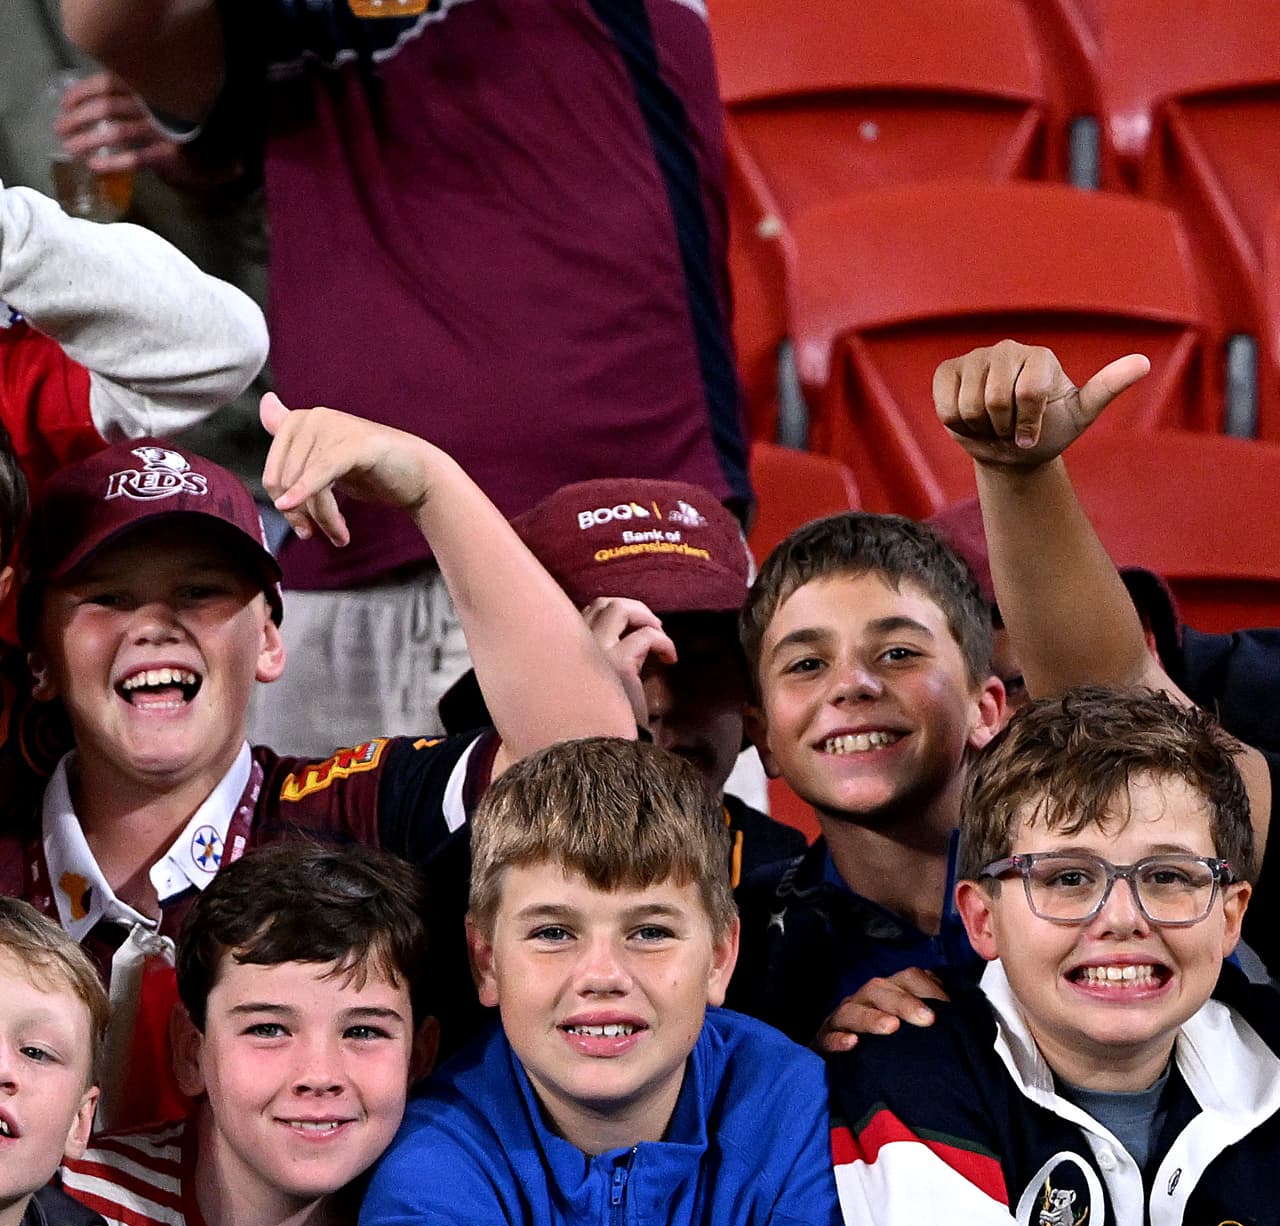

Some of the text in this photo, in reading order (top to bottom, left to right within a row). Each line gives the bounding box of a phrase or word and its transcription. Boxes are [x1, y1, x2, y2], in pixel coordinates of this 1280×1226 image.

[104, 469, 208, 500] REDS
[578, 504, 633, 530] BOQ
[623, 529, 680, 543] Bank of
